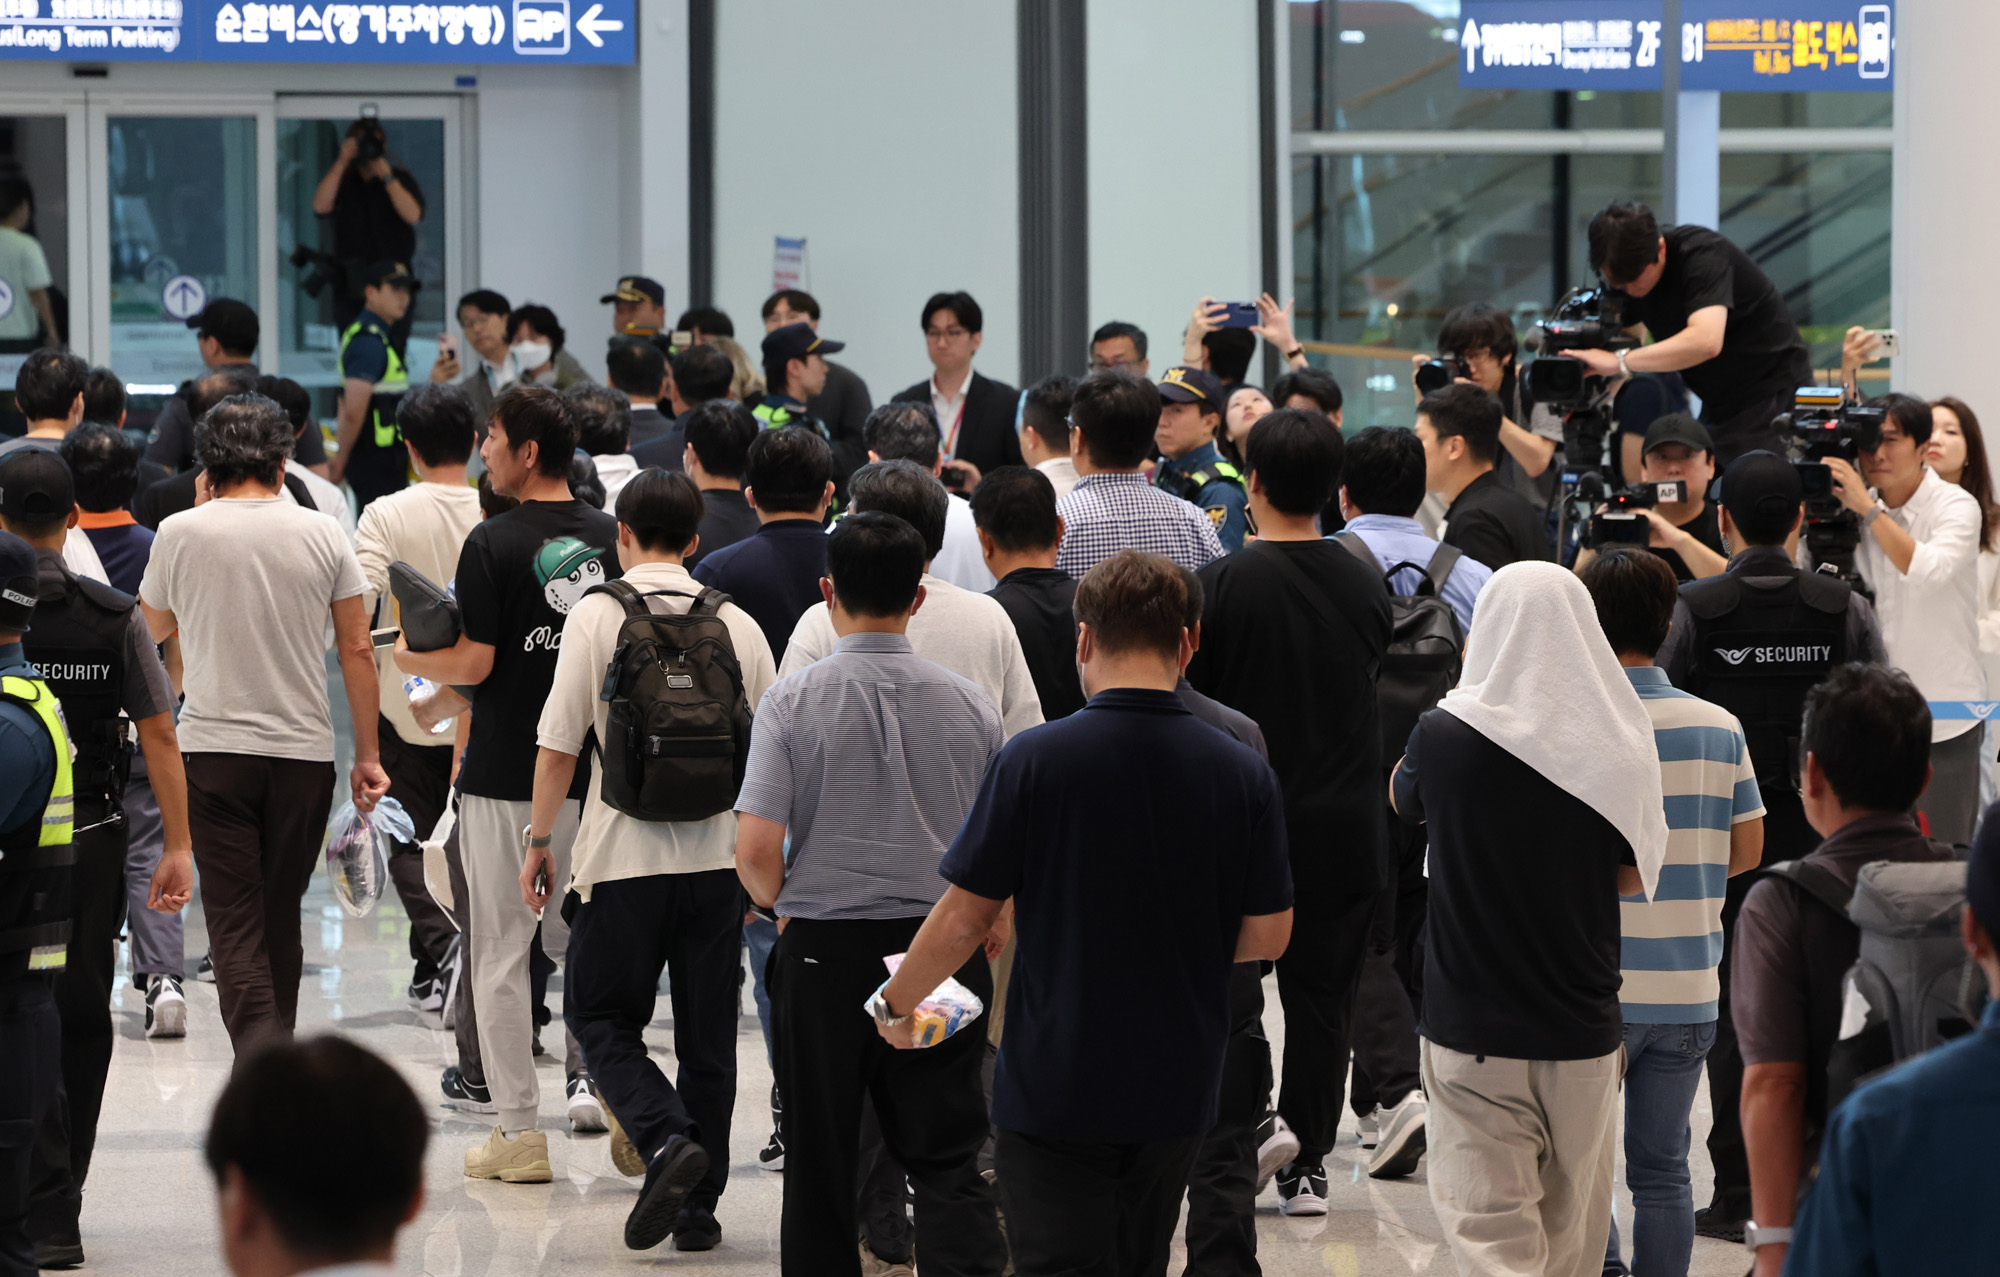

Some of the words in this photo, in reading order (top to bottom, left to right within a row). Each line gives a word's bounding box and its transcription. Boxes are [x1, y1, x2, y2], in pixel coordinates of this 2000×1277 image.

[215, 2, 505, 45] 순환버스(장기주차장행)
[63, 26, 108, 47] Term
[111, 26, 181, 52] Parking)
[1636, 20, 1662, 67] 2F
[1659, 487, 1677, 499] AP
[1754, 645, 1831, 663] SECURITY
[31, 663, 110, 680] SECURITY
